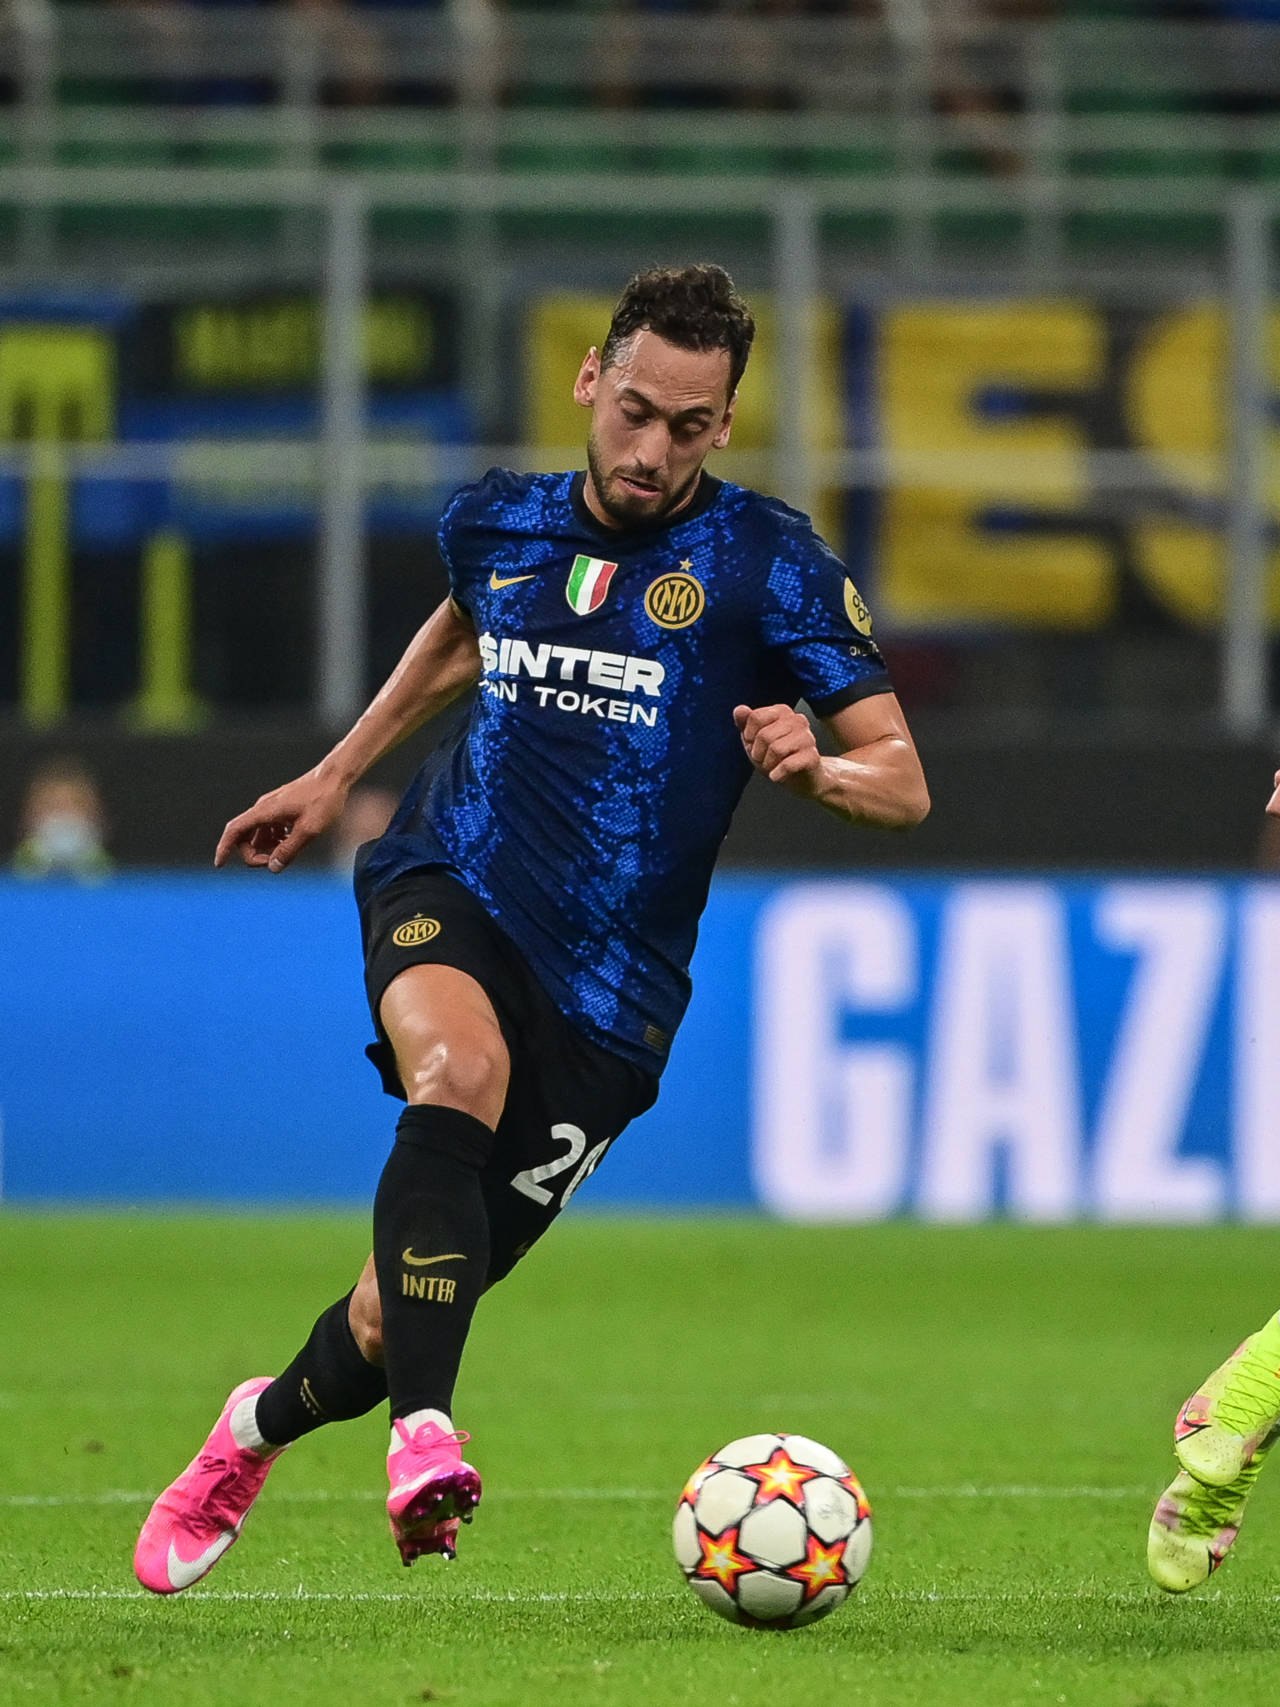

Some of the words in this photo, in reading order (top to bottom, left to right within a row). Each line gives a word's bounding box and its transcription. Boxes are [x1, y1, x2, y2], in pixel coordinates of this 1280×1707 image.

[478, 631, 666, 697] $INTER
[533, 685, 658, 728] TOKEN
[402, 1272, 457, 1304] INTER
